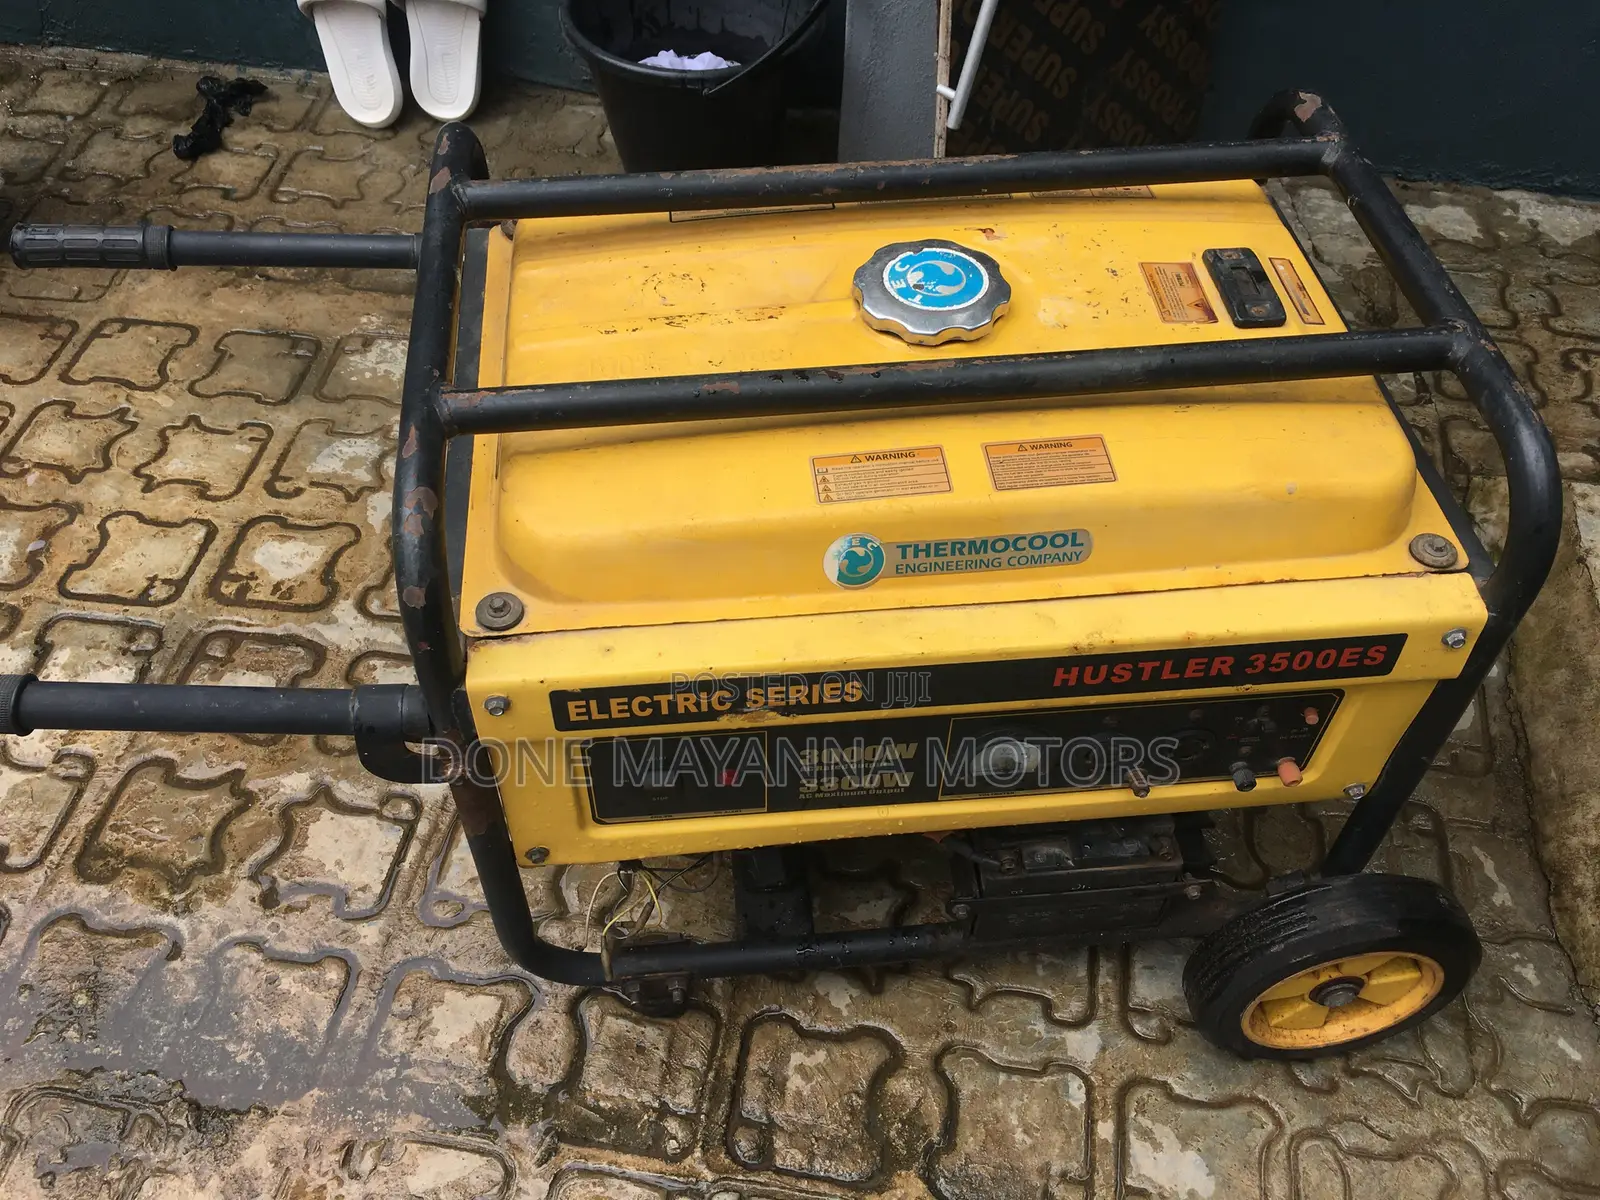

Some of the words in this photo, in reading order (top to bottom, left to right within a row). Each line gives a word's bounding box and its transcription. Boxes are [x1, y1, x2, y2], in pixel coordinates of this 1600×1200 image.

[865, 450, 916, 463] WARNING
[1030, 441, 1074, 451] WARNING
[896, 532, 1084, 559] THERMOCOOL
[895, 557, 1003, 575] ENGINEERING
[1007, 550, 1083, 568] COMPANY
[1053, 654, 1235, 688] HUSTLER
[1245, 644, 1388, 675] 3500ES
[567, 690, 734, 722] ELECTRIC
[745, 680, 864, 709] SERIES
